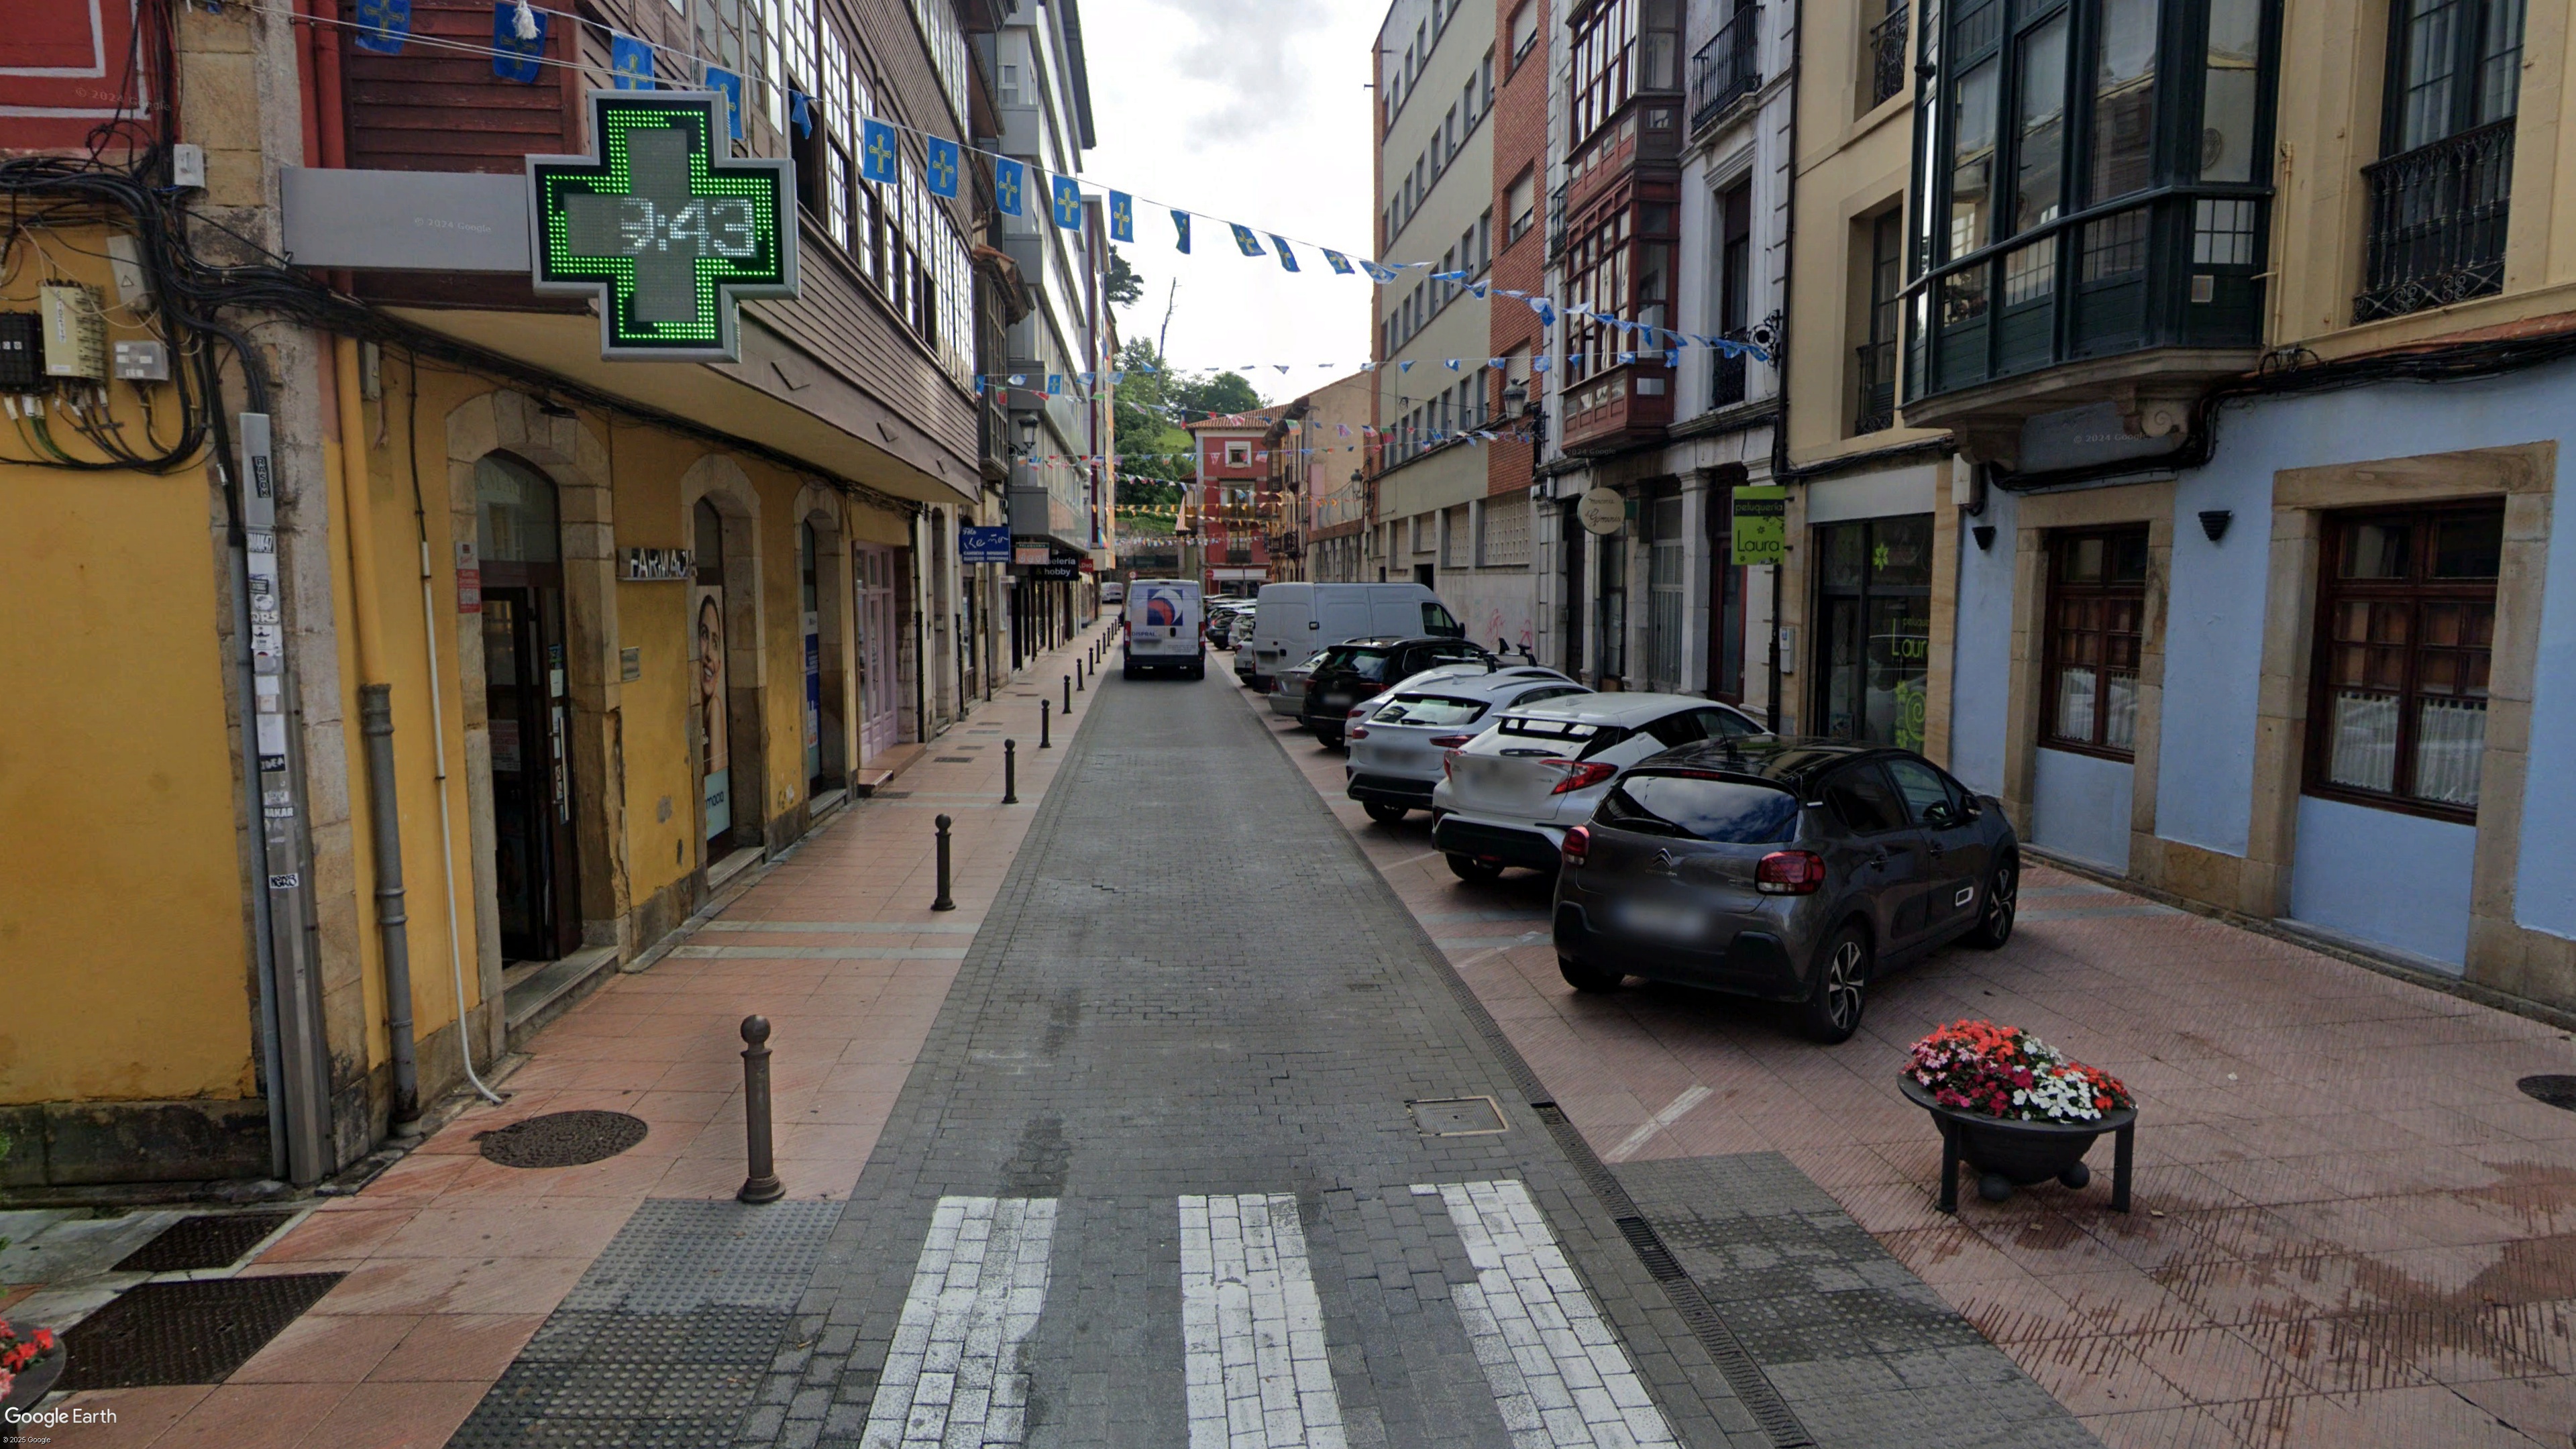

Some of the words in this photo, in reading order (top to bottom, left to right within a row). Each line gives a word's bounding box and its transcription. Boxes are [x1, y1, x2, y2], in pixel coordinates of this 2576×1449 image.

[1735, 502, 1783, 514] peluquería
[1737, 529, 1780, 552] Laura
[630, 547, 698, 578] FARMACIA
[1044, 568, 1071, 577] hobby
[1892, 618, 1930, 659] Laur
